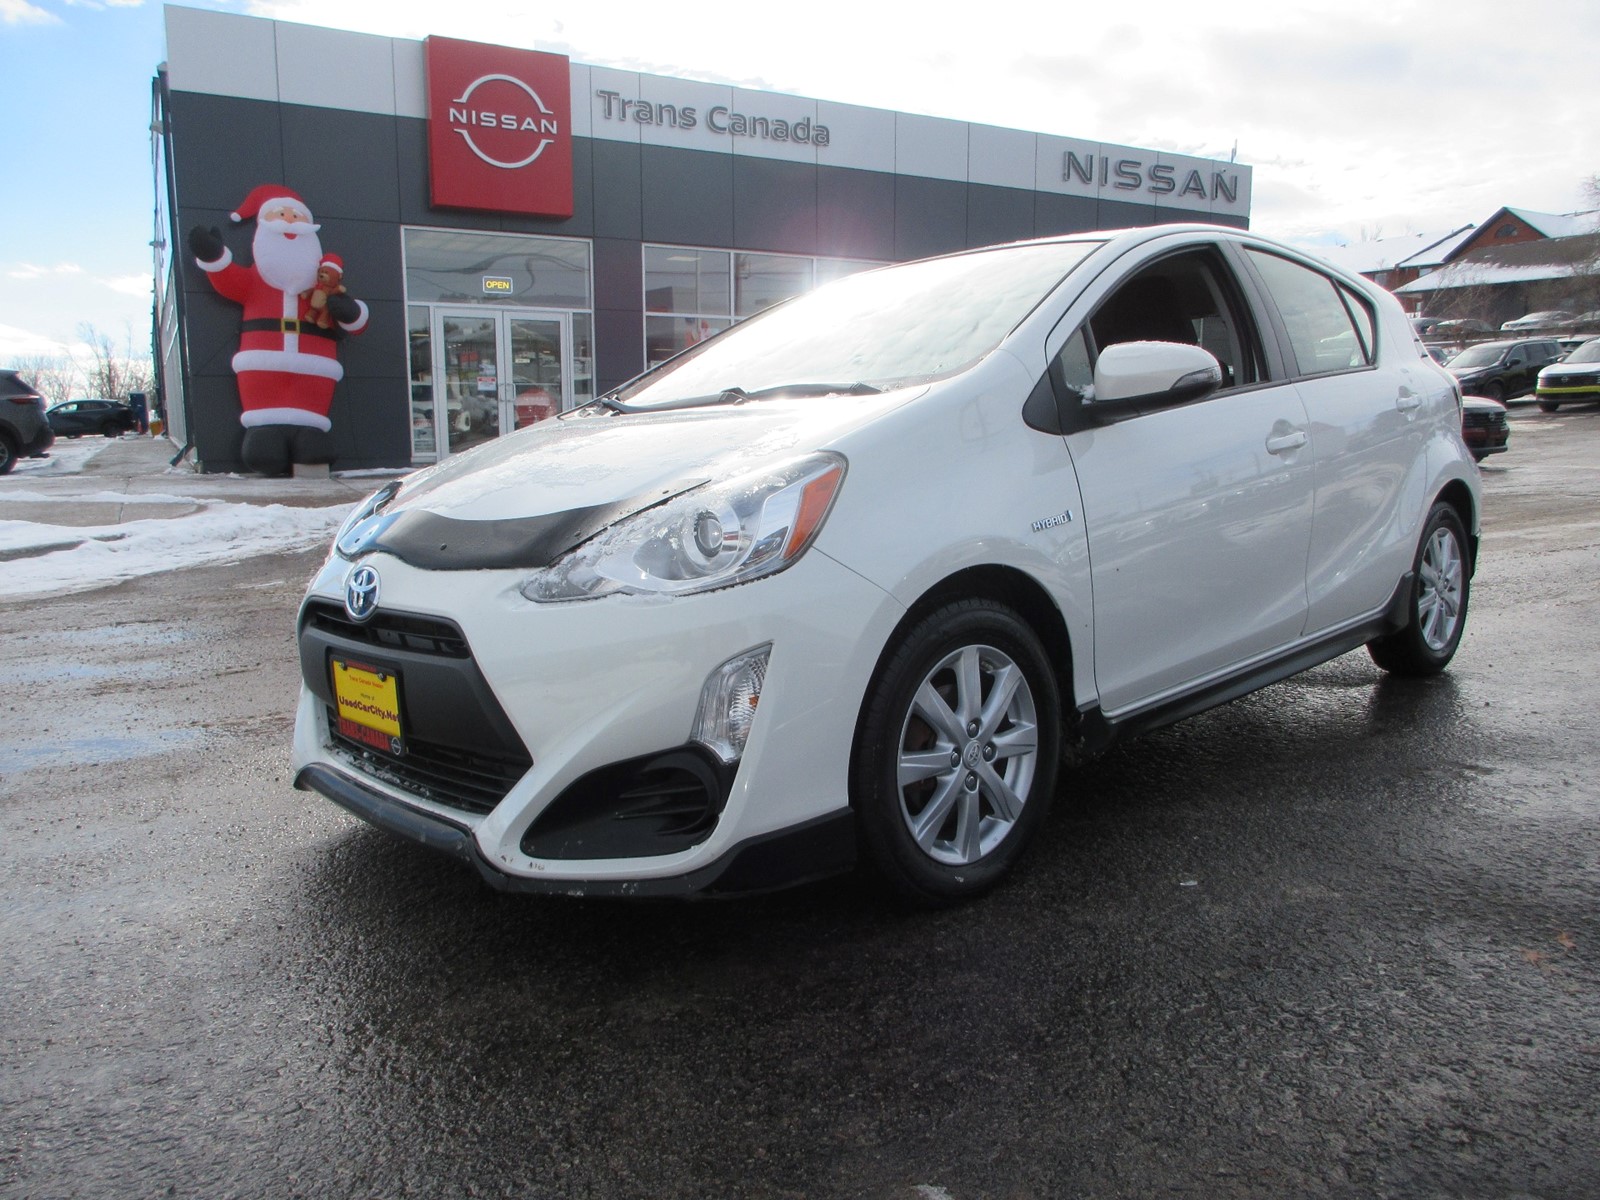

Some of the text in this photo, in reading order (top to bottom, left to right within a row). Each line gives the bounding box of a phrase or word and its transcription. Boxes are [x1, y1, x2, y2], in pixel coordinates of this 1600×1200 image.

[449, 106, 557, 134] NISSAN
[598, 90, 831, 146] Trans Canada
[1063, 150, 1238, 202] NISSAN
[485, 280, 510, 289] OPEN
[1032, 513, 1068, 532] HYBRID
